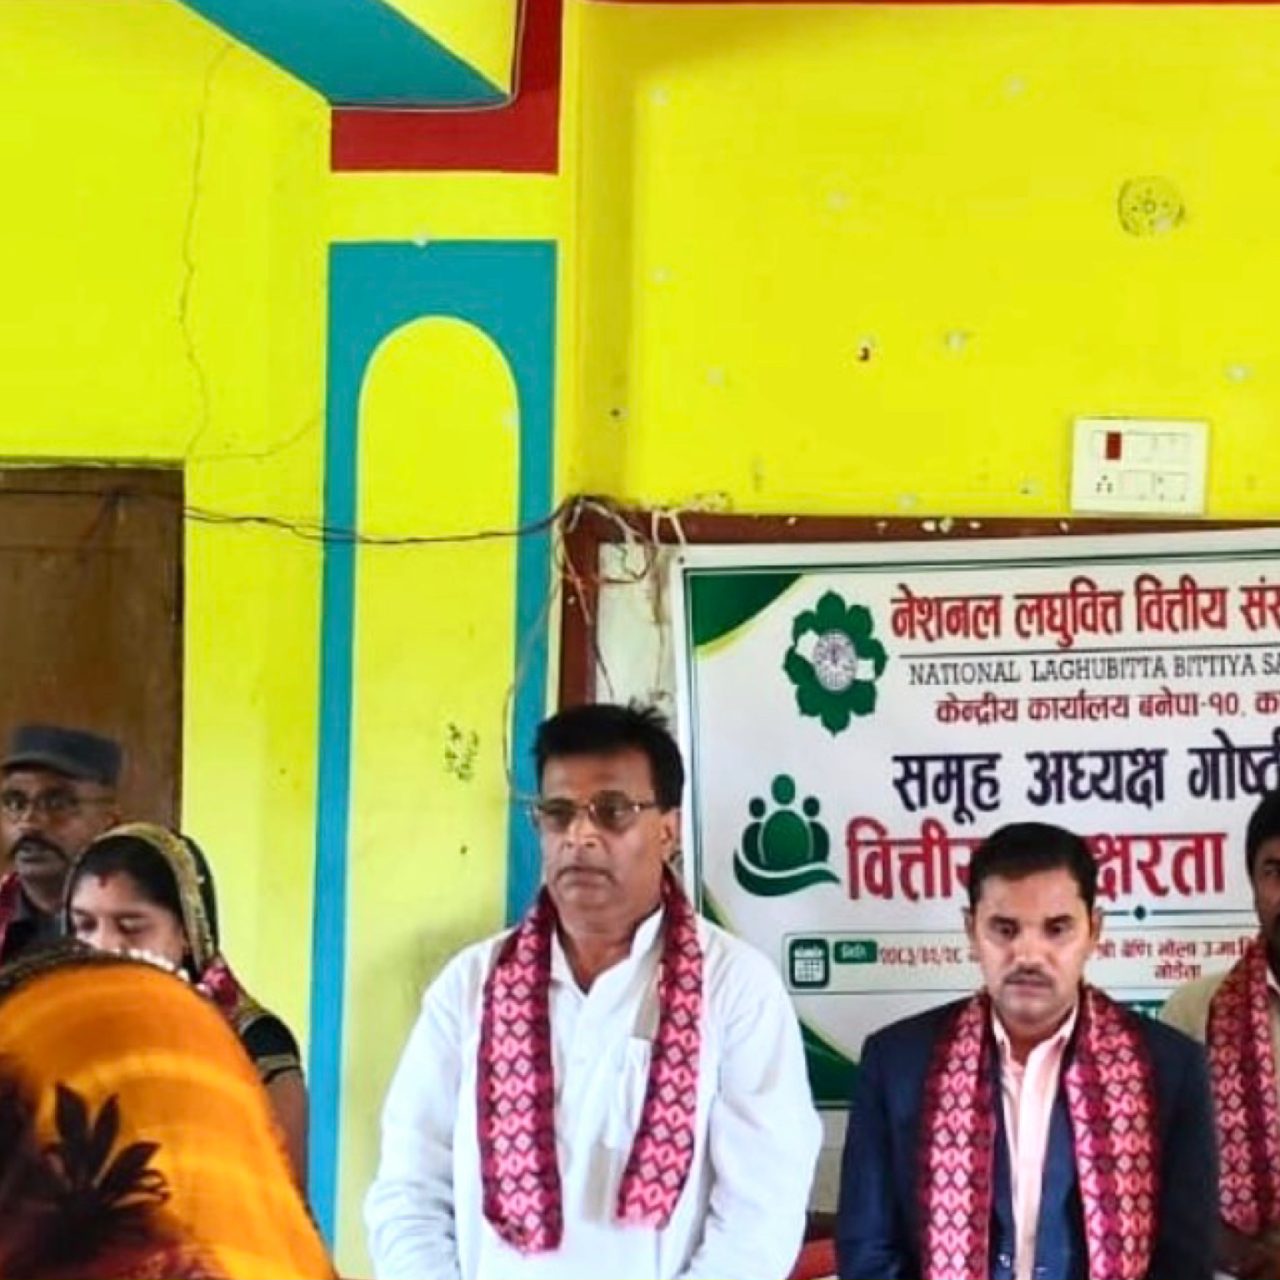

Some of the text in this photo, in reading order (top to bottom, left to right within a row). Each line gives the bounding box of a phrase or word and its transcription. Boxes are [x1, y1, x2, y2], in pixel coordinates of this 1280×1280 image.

[890, 582, 1003, 642] नेशनल
[1014, 575, 1124, 648] लघुवित्त
[1134, 573, 1228, 633] वित्तीय
[909, 659, 1020, 686] NATIONAL
[1030, 654, 1168, 683] LAGHUBITTA
[1173, 651, 1256, 679] BITTIYA
[935, 691, 1019, 725] केन्द्रीय
[1027, 687, 1130, 721] कार्यालय
[892, 752, 1002, 824] समूह
[1025, 747, 1168, 806] अध्यक्ष
